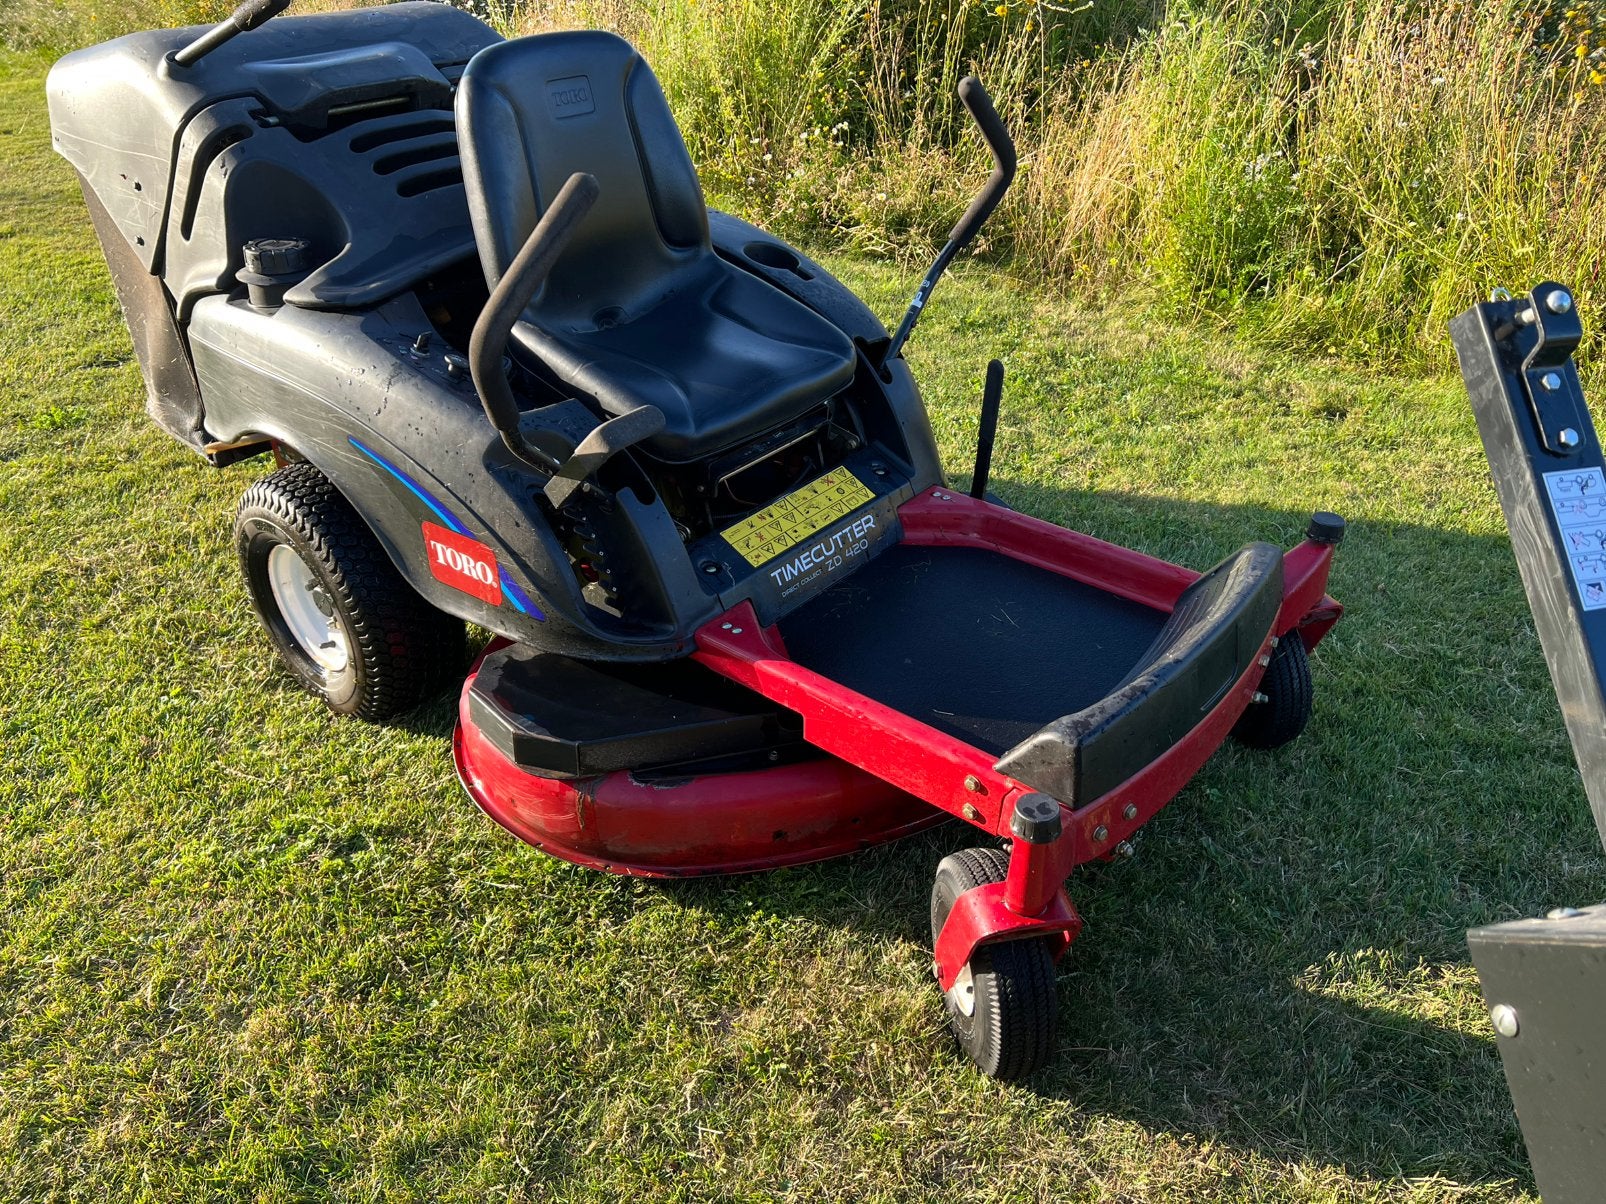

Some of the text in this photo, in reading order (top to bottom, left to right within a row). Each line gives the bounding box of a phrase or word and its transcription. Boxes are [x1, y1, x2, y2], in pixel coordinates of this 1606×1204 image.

[770, 514, 876, 587] TIMECUTTER
[781, 538, 869, 598] DIRECT COLLECT ZD 420
